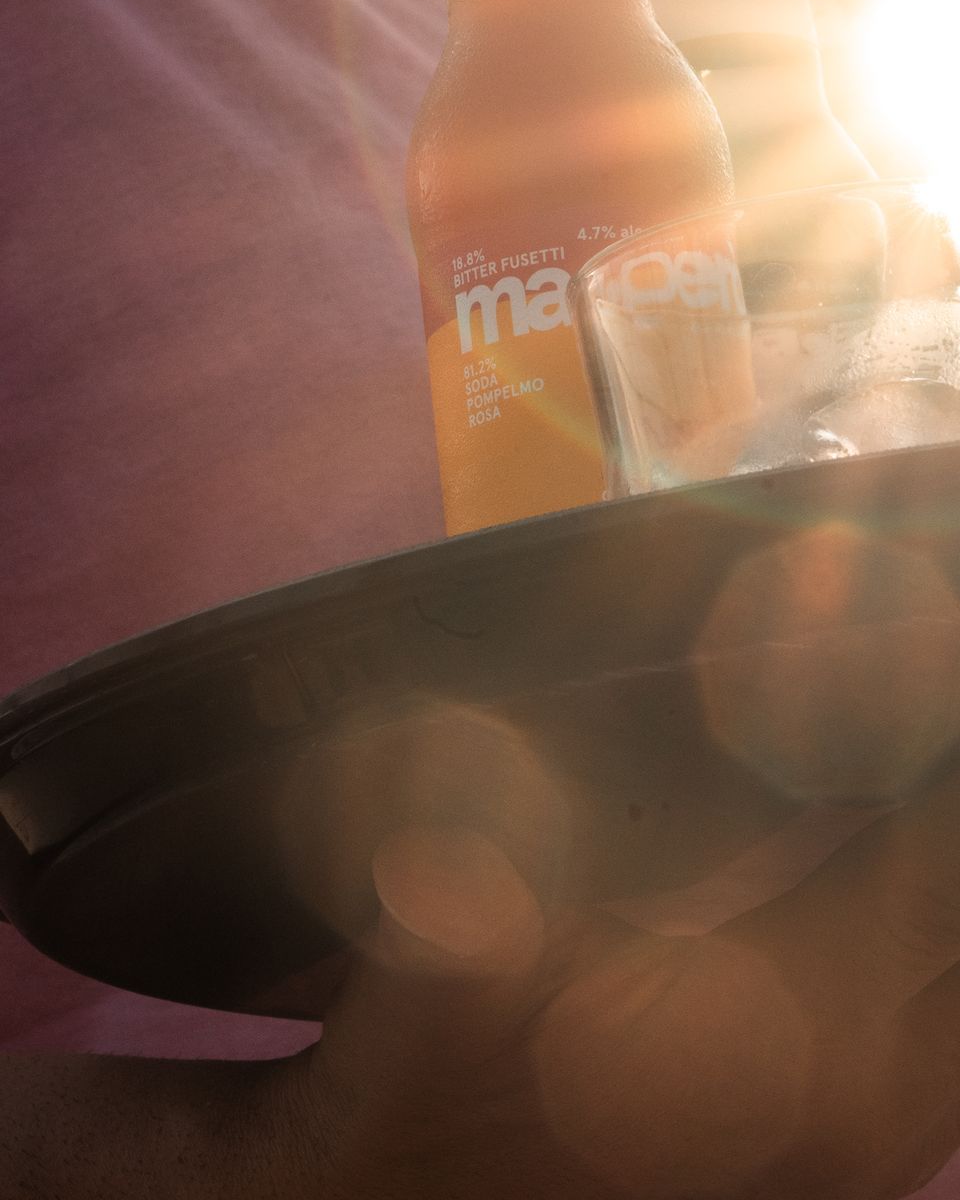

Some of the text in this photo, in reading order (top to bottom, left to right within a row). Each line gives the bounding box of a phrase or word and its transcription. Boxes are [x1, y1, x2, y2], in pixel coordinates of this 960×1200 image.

[577, 225, 616, 241] 4.7%
[452, 247, 486, 272] 18.8%
[453, 246, 566, 289] BITTER FUSETTI
[463, 357, 497, 379] 81.2%
[465, 374, 498, 395] SODA
[467, 377, 545, 411] POMPELMO
[468, 405, 502, 428] ROSA
